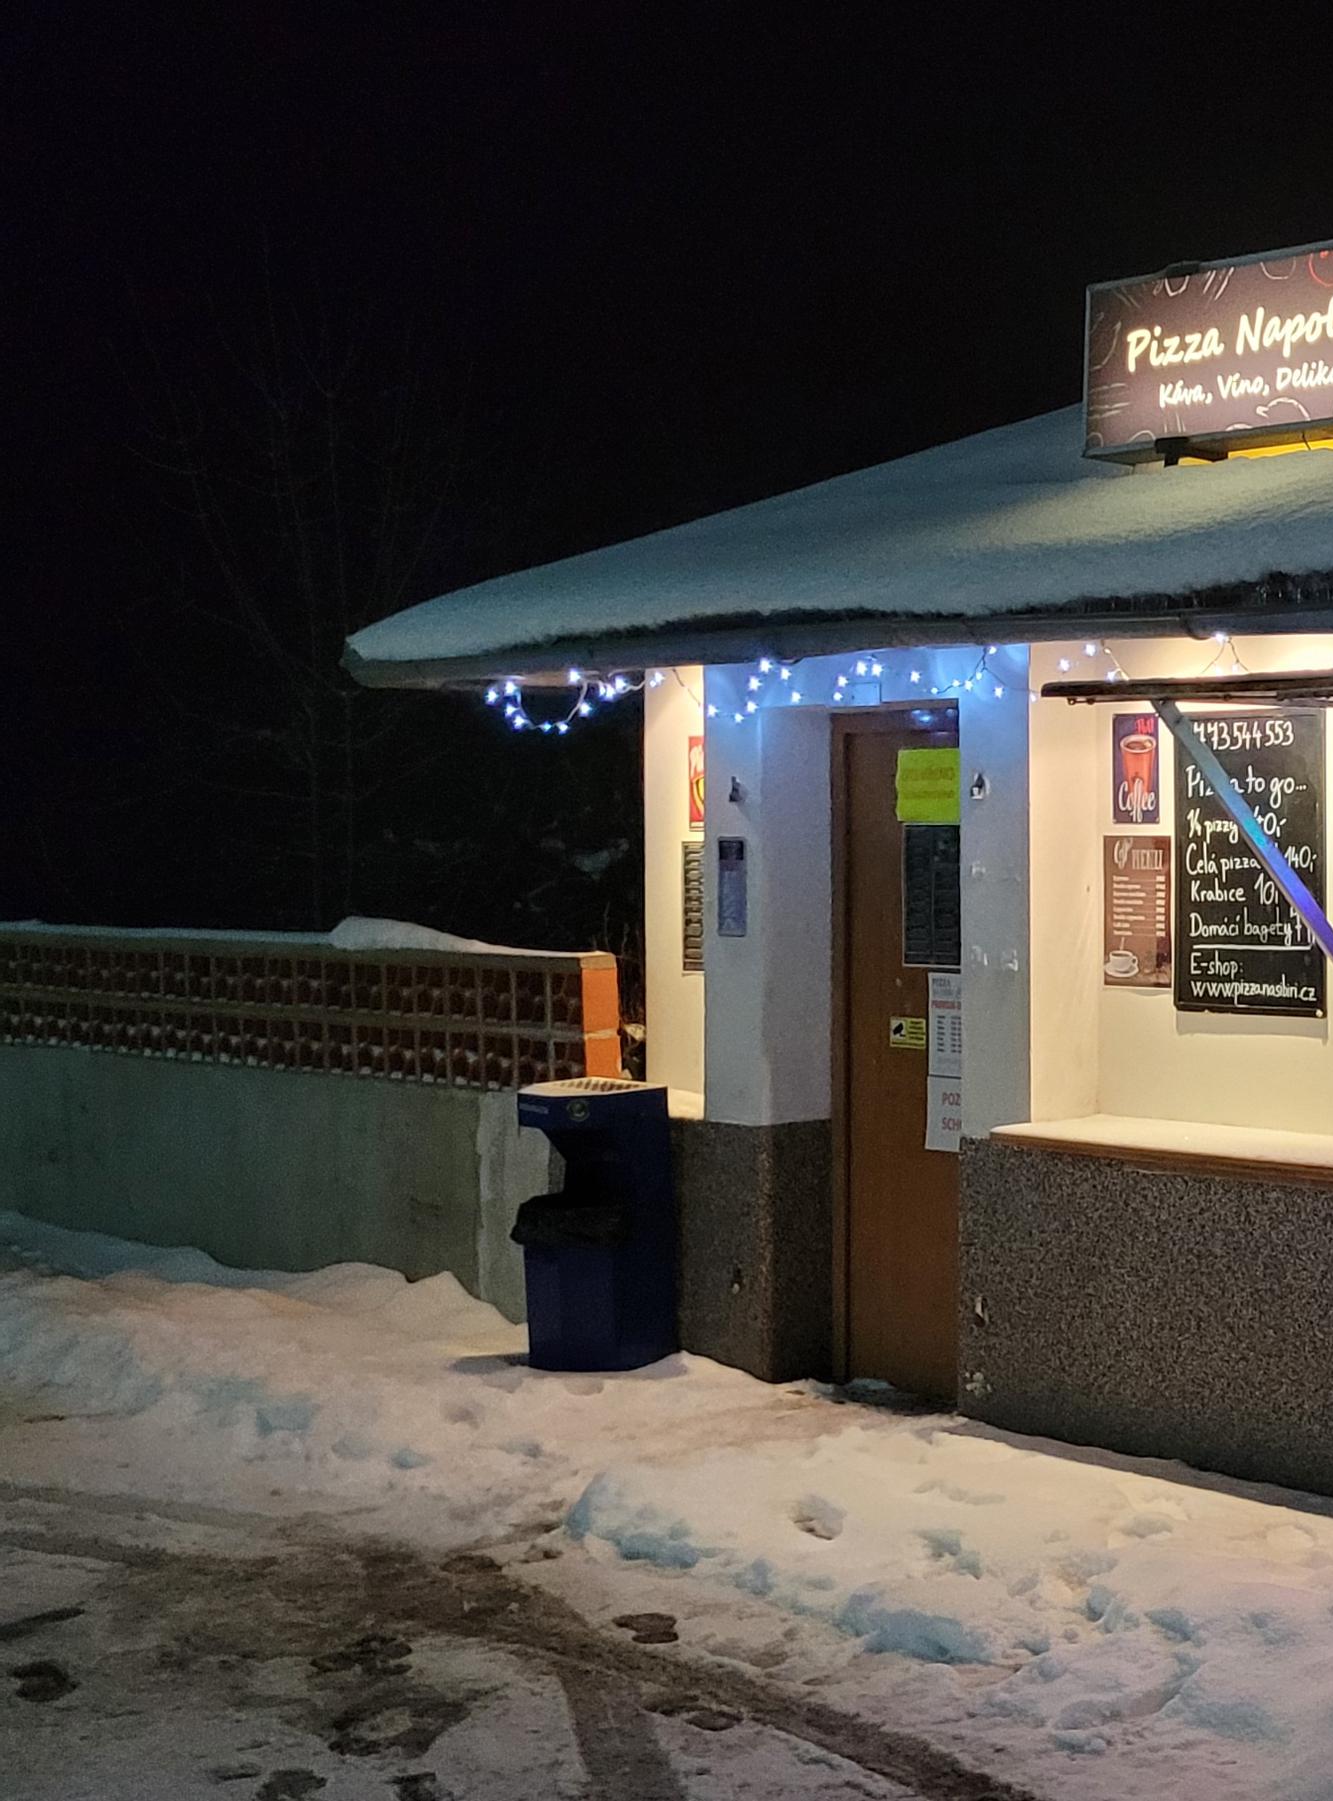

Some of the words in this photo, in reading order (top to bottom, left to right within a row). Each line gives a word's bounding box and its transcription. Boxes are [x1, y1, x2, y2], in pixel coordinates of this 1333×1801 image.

[1127, 325, 1223, 372] Pizza
[1159, 380, 1213, 409] Káva,
[1217, 372, 1270, 397] Víno,
[1246, 764, 1266, 794] to
[1119, 778, 1157, 823] Coffee
[1204, 818, 1239, 844] pizzy
[1186, 840, 1219, 876] Celá
[1220, 855, 1261, 883] pizza
[1191, 876, 1247, 902] Krabice
[1243, 906, 1293, 946] bagety
[942, 1093, 961, 1106] POZ
